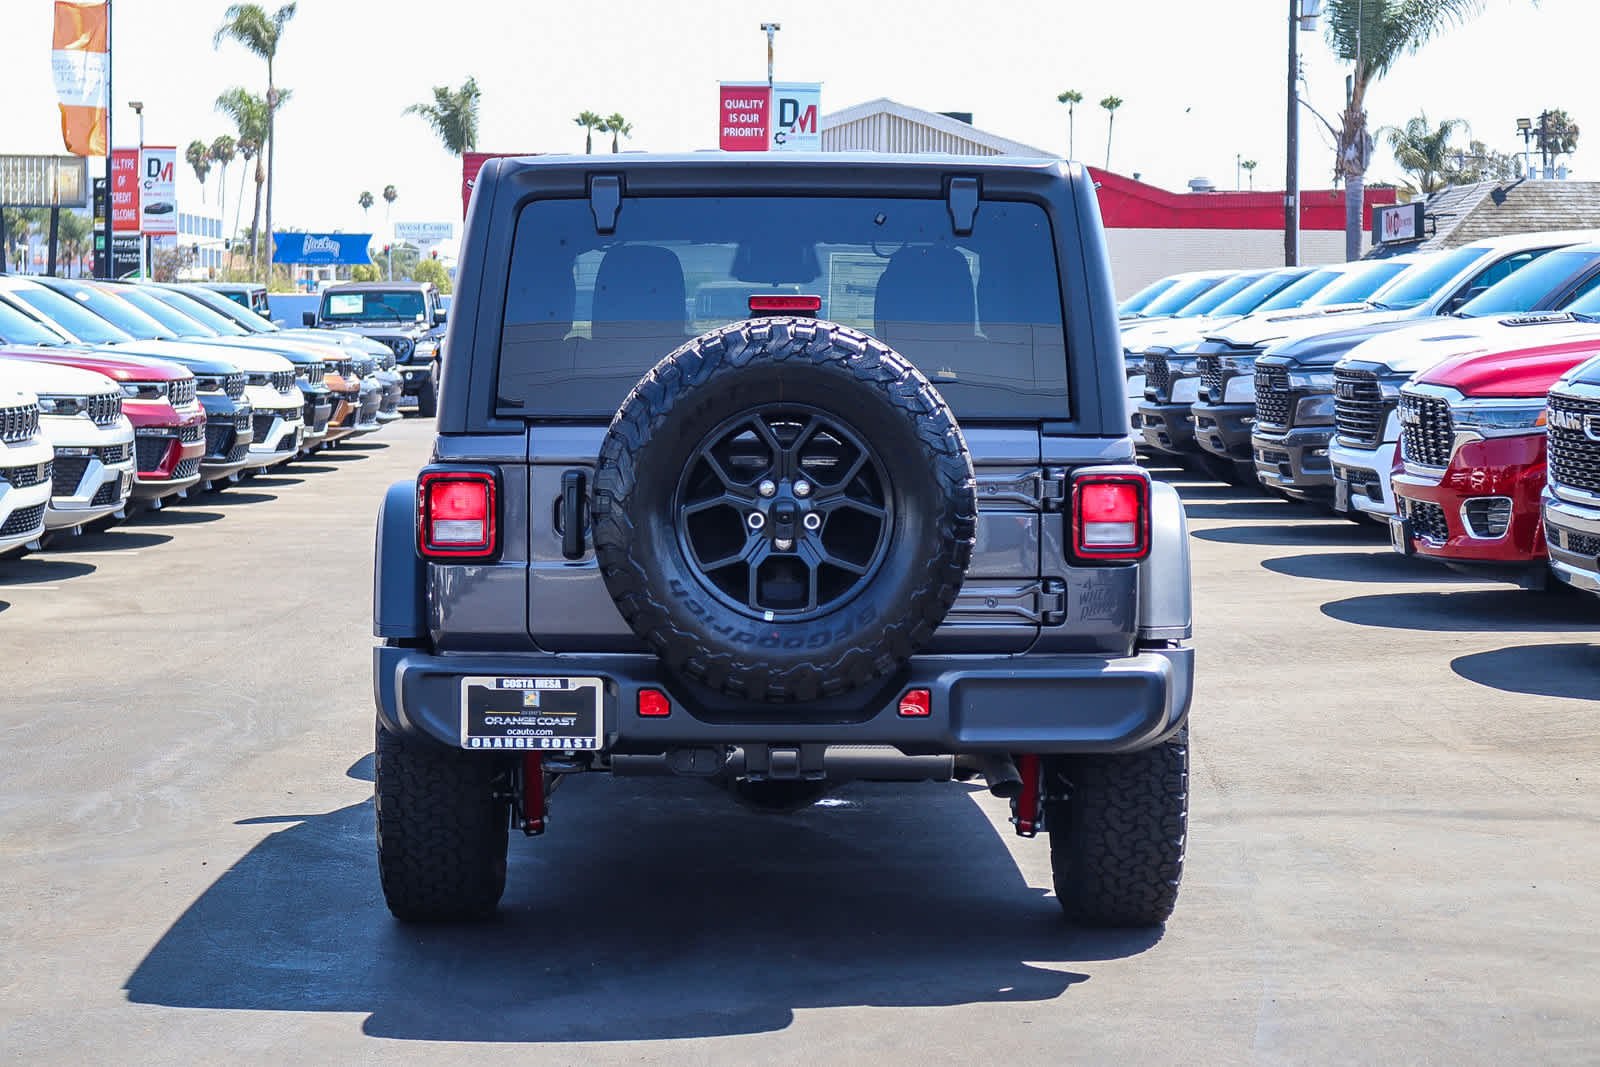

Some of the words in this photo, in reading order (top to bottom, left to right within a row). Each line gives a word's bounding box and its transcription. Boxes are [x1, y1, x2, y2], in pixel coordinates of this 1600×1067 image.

[724, 99, 764, 109] QUALITY
[729, 113, 738, 123] IS
[740, 113, 759, 123] OUR
[723, 127, 765, 137] PRIORITY
[502, 679, 534, 688] COSTA
[535, 679, 562, 689] MESA
[484, 716, 536, 726] ORANGE
[537, 716, 577, 726] COAST
[506, 727, 554, 736] ocauto.com
[471, 738, 534, 748] ORANGE
[541, 738, 593, 748] COAST
